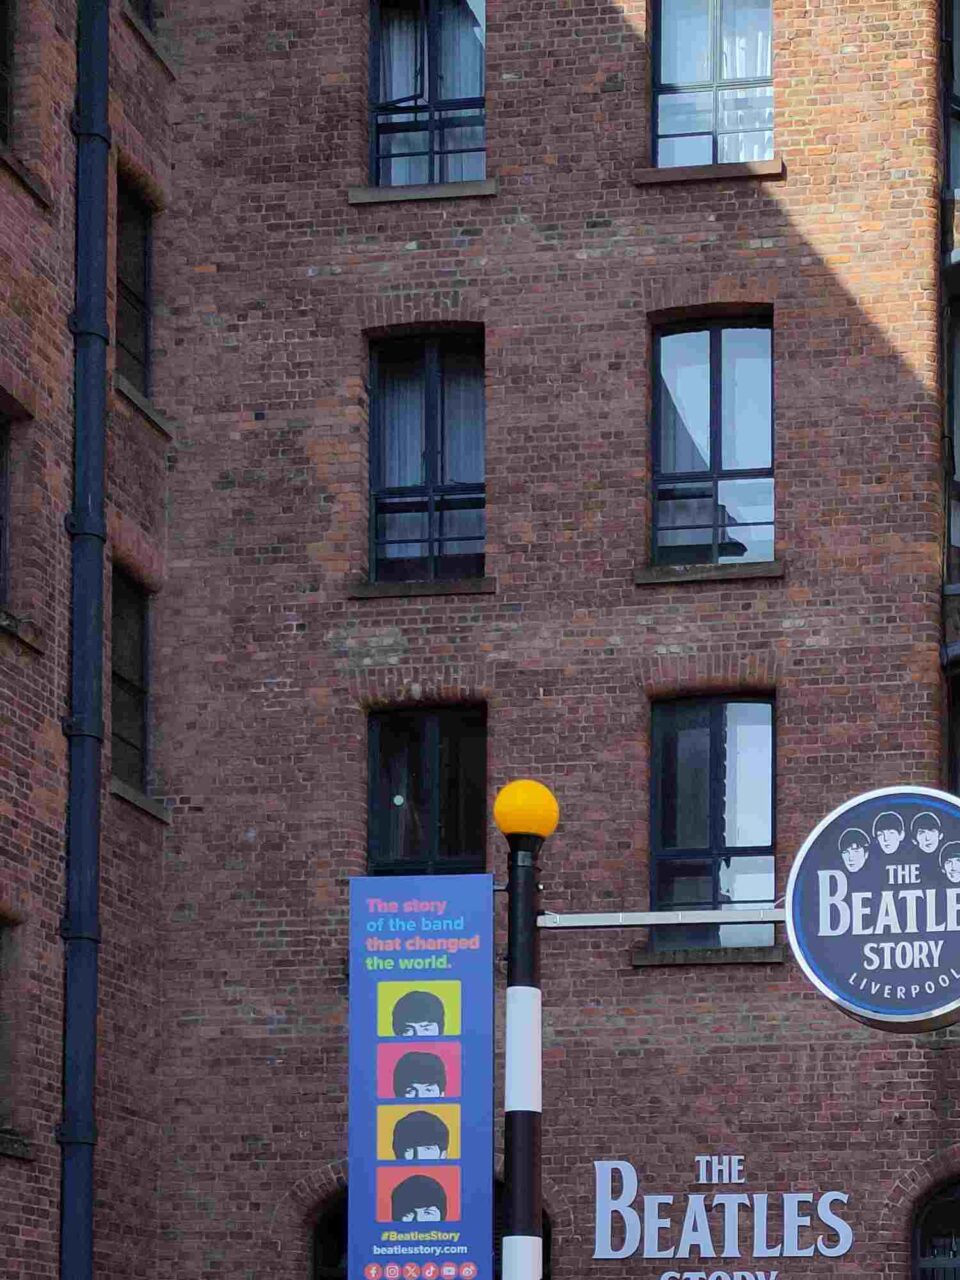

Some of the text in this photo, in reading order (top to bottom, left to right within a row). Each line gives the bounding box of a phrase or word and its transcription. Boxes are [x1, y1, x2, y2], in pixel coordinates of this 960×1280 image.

[886, 864, 921, 884] THE
[367, 898, 447, 914] The story
[366, 916, 464, 932] of the band
[365, 935, 480, 953] that changed
[365, 954, 452, 970] the world.
[863, 940, 944, 970] STORY
[695, 1155, 746, 1184] THE
[592, 1159, 854, 1259] BEATLES
[381, 1231, 460, 1241] #BeatlesStory
[373, 1245, 467, 1256] beatlesstory.com
